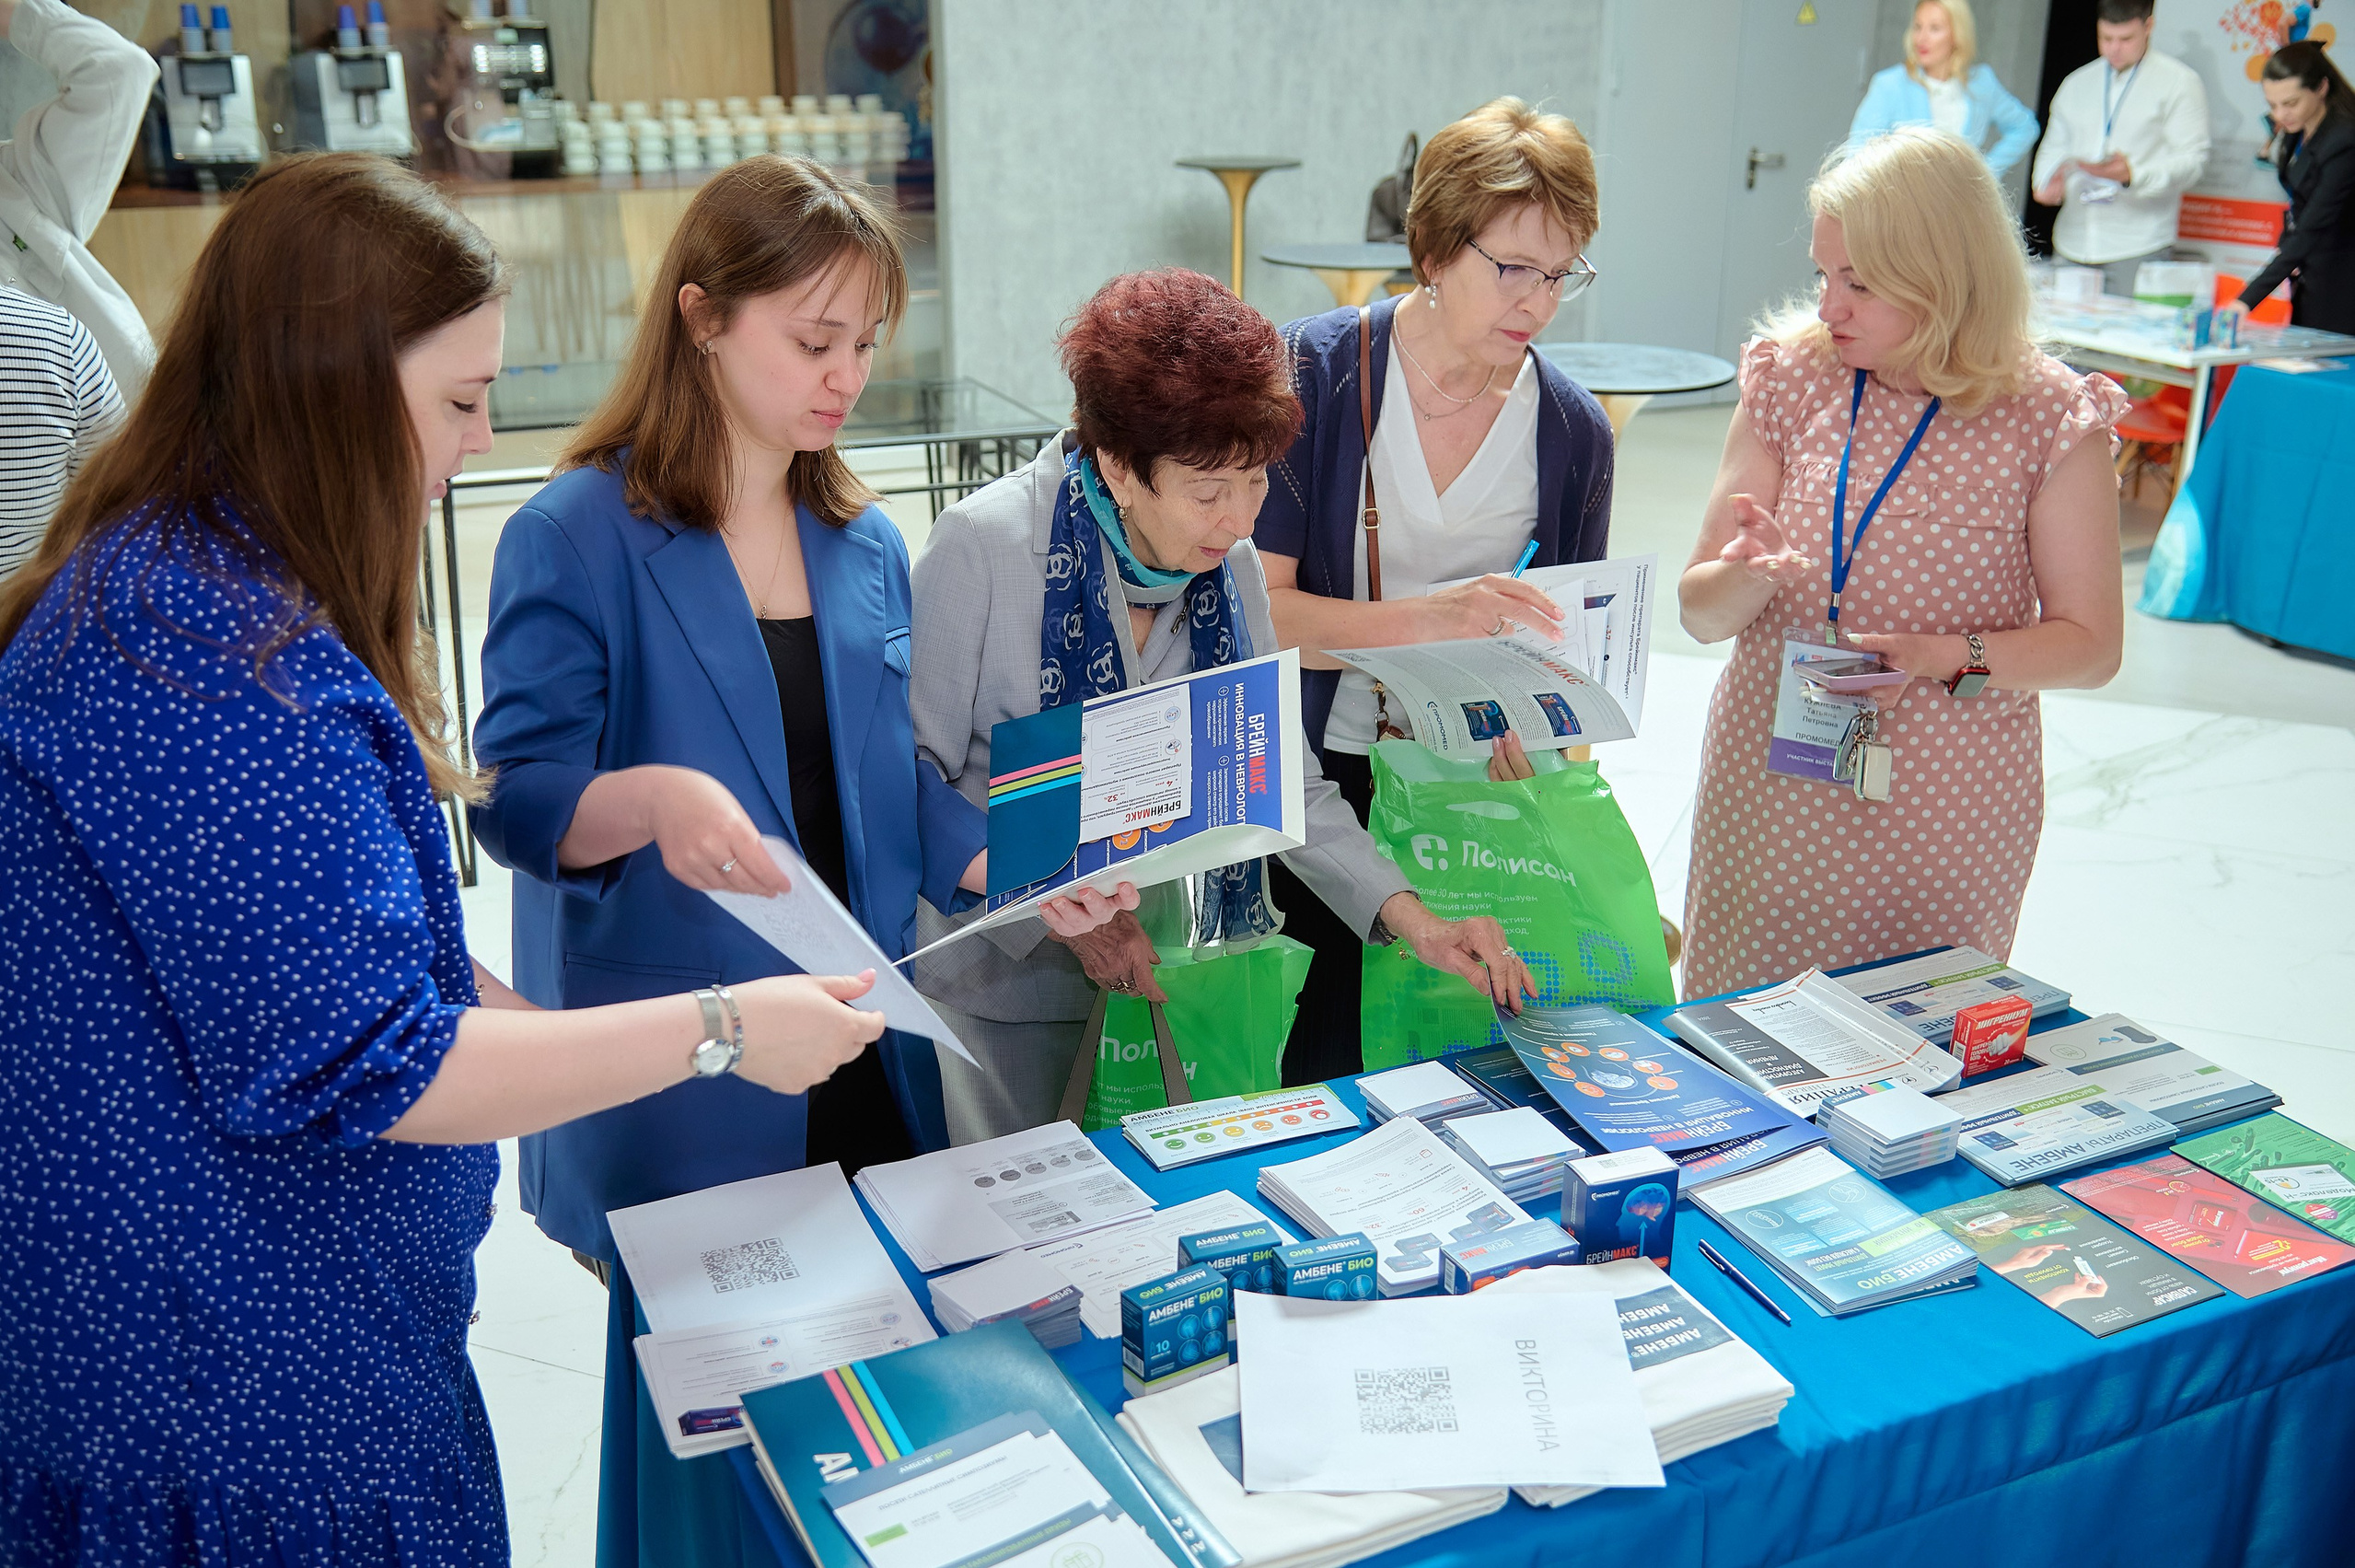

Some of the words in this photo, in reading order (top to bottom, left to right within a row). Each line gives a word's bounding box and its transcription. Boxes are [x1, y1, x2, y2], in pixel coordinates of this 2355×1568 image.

[1232, 682, 1245, 751] ИННОВАЦИЯ
[1802, 715, 1839, 727] Петровна
[1806, 707, 1837, 718] Татьяна
[1236, 752, 1245, 761] В
[1786, 753, 1814, 763] УЧАСТНИК
[1235, 762, 1246, 827] НЕВРОЛОГ
[1458, 840, 1579, 887] Полисан
[1437, 889, 1446, 897] 30
[1484, 892, 1537, 904] используем
[1918, 1015, 1956, 1033] БЕНЕ
[1098, 1034, 1198, 1080] Полн
[1745, 1051, 1778, 1066] ЛЕЧЕНИЯ
[1759, 1064, 1804, 1084] АЛГОРИТМЫ
[1123, 1081, 1164, 1094] использ
[1781, 1080, 1827, 1098] THERAPY
[1130, 1109, 1174, 1121] АМБЕНЕ
[1175, 1104, 1198, 1112] БИО
[1683, 1105, 1754, 1126] ИННОВАЦИЯ
[1649, 1118, 1732, 1144] БРЕЙНМАКС
[1674, 1121, 1682, 1129] В
[2083, 1119, 2166, 1149] ПРЕПАРАТЫ
[1673, 1147, 1709, 1164] НЕВРО
[1709, 1144, 1719, 1153] В
[1196, 1232, 1239, 1246] АМБЕНЕ
[1242, 1227, 1266, 1237] БИО
[1317, 1237, 1360, 1252] АМБЕНЕ
[1869, 1226, 1914, 1246] ИНЪЕКЦИЙ
[1289, 1247, 1313, 1258] БИО
[1802, 1256, 1821, 1265] БОЛИ
[1828, 1247, 1855, 1259] МЕСЯЦЕВ
[1206, 1253, 1248, 1270] МБЕНЕ
[1293, 1262, 1342, 1280] АМБЕНЕ
[1348, 1256, 1374, 1271] БИО
[1892, 1242, 1967, 1281] АМБЕНЕ
[1164, 1270, 1206, 1290] АМБЕНЕ
[2021, 1266, 2055, 1279] ПРИРОДЫ
[2024, 1267, 2071, 1283] КОМПОНЕНТЫ
[1853, 1270, 1897, 1293] БИО
[1139, 1283, 1164, 1300] БИО
[2146, 1284, 2198, 1306] САЛВИСАР
[1148, 1295, 1194, 1321] АМБЕНЕ
[1199, 1285, 1224, 1304] БИО
[1618, 1302, 1671, 1325] АМБЕН
[1155, 1339, 1169, 1353] 10
[1514, 1339, 1560, 1453] ВИКТОРИНА
